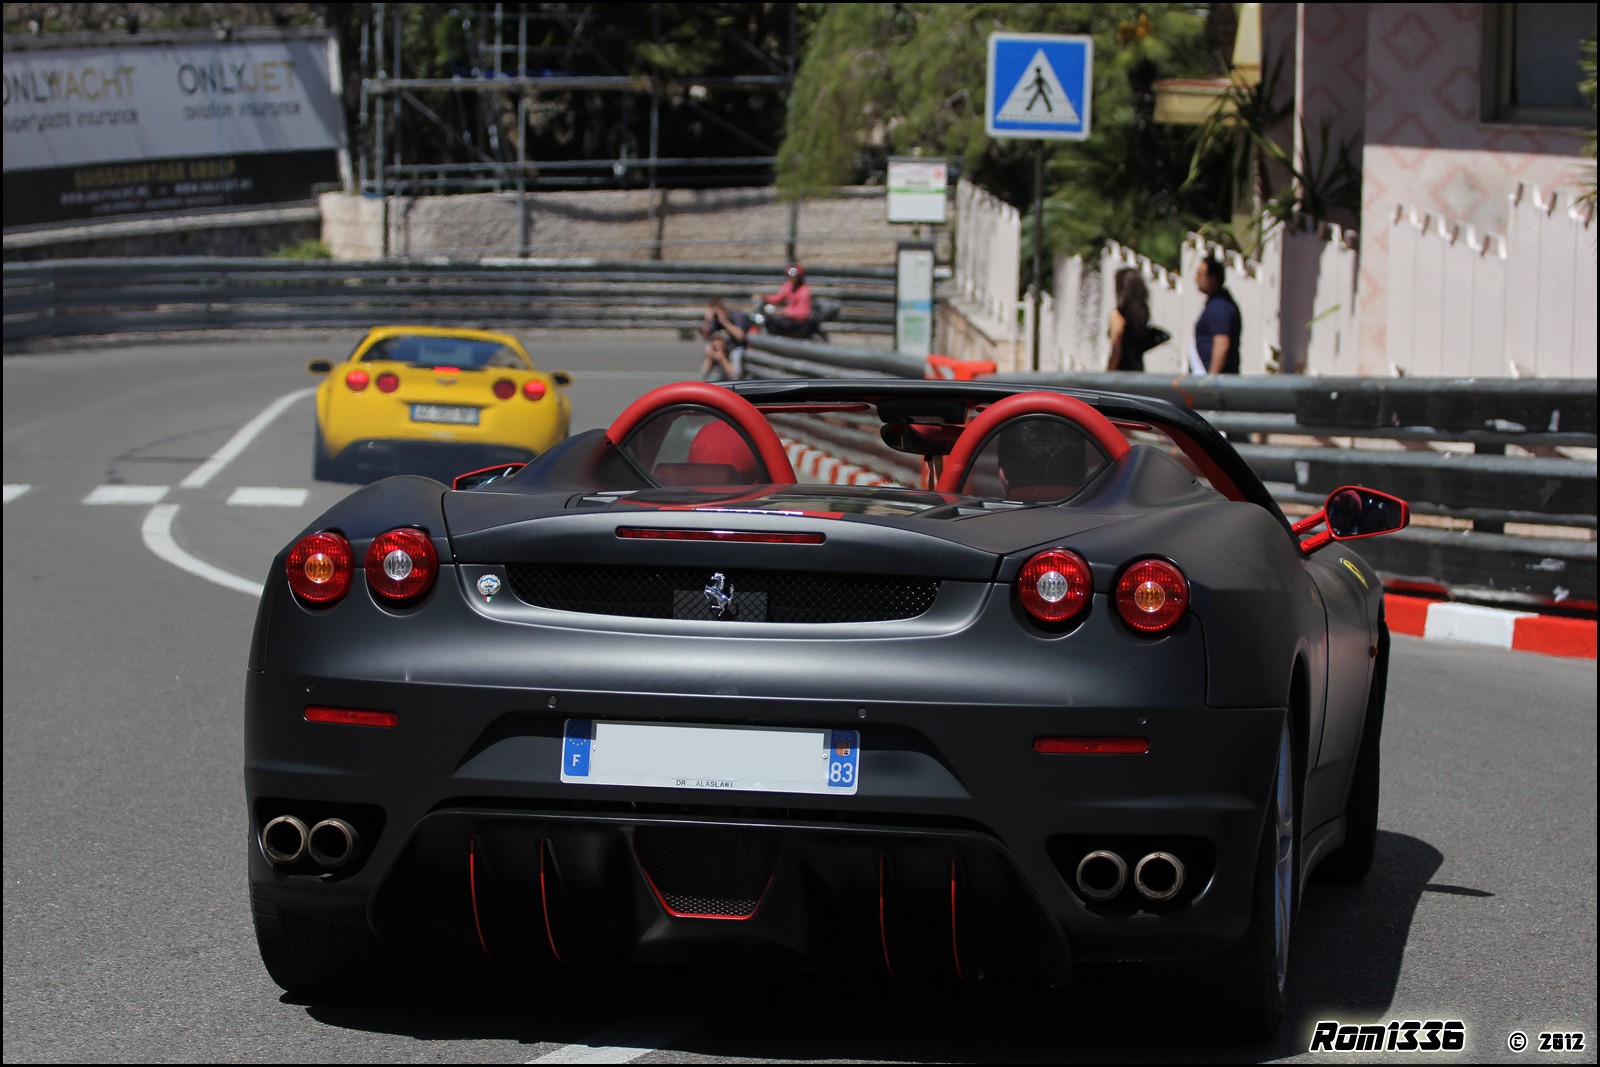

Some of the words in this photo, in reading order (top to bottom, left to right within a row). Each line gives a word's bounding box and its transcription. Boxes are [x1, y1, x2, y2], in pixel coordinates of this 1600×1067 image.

[177, 61, 297, 96] ONLYJET
[572, 754, 581, 767] F
[830, 761, 854, 783] 83
[695, 780, 733, 788] ALASLAWI
